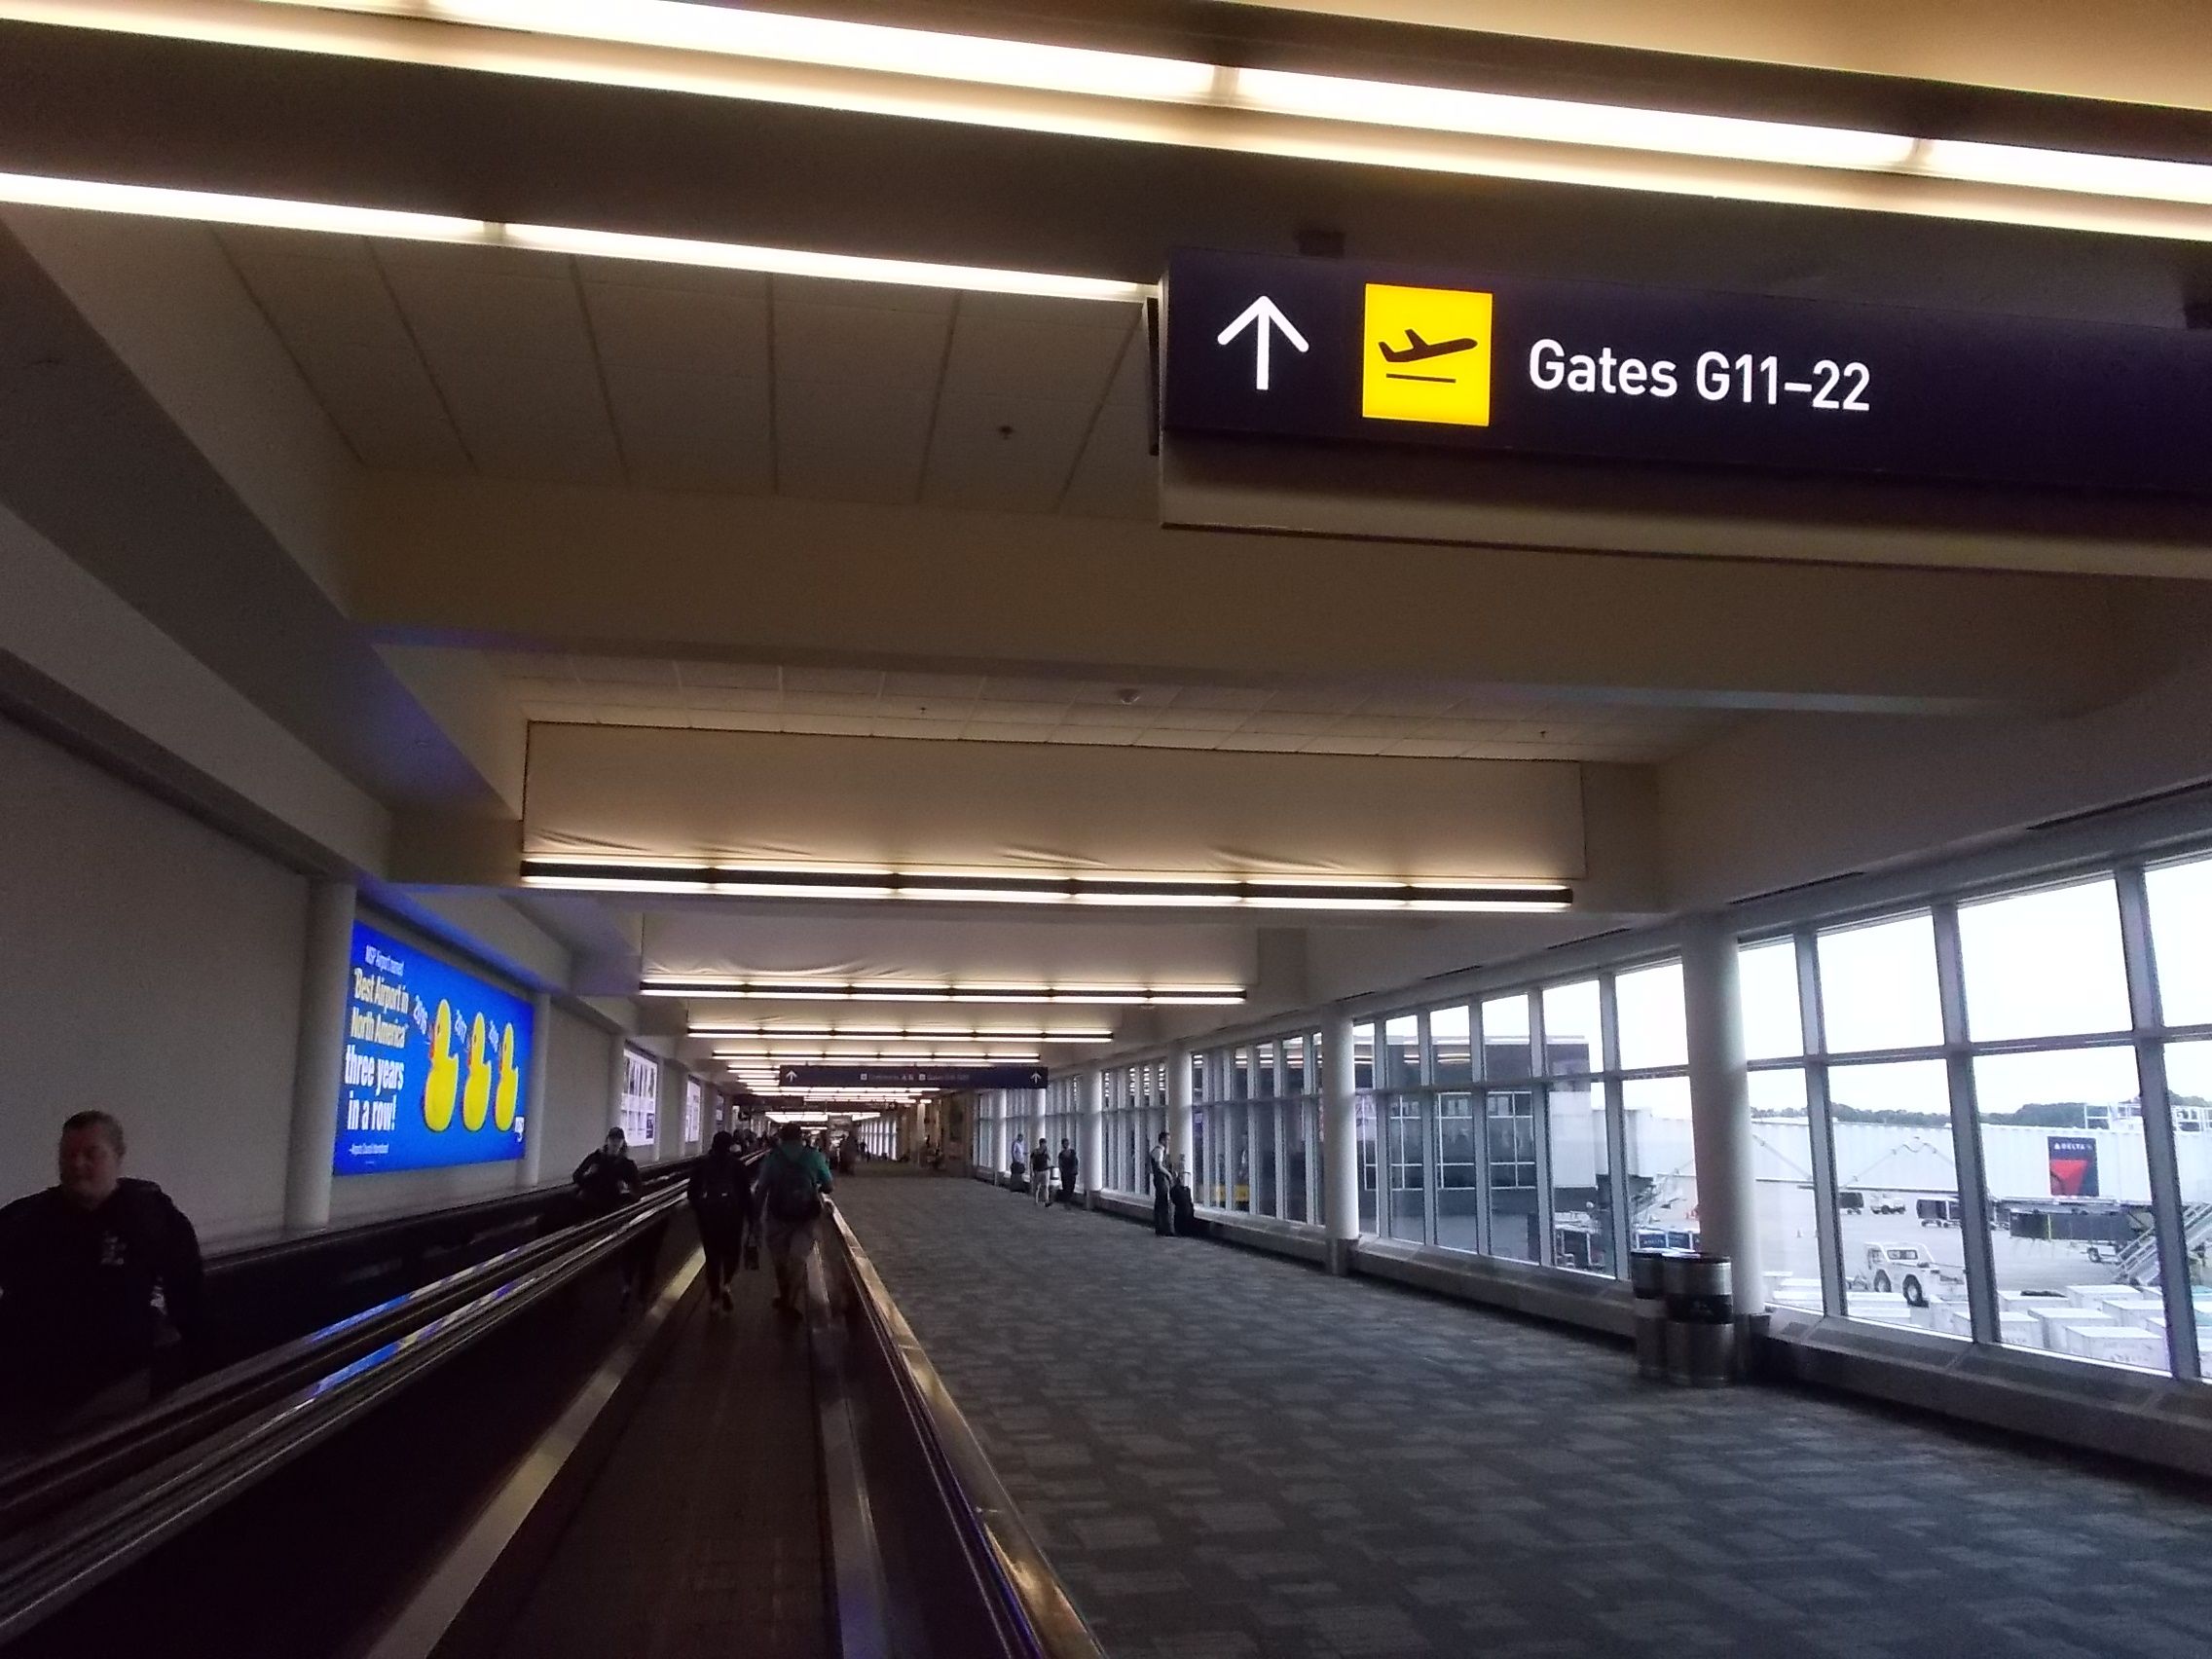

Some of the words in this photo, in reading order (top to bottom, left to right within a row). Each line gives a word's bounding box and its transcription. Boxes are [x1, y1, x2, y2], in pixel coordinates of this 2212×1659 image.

[1530, 339, 1677, 397] Gates
[375, 976, 400, 1014] Airport
[401, 984, 409, 1014] in
[350, 1006, 374, 1041] North
[345, 1044, 375, 1087] three
[375, 1058, 404, 1096] years
[347, 1090, 360, 1130] in
[361, 1100, 370, 1130] a
[371, 1094, 397, 1131] row!
[2061, 1142, 2085, 1151] DELTA
